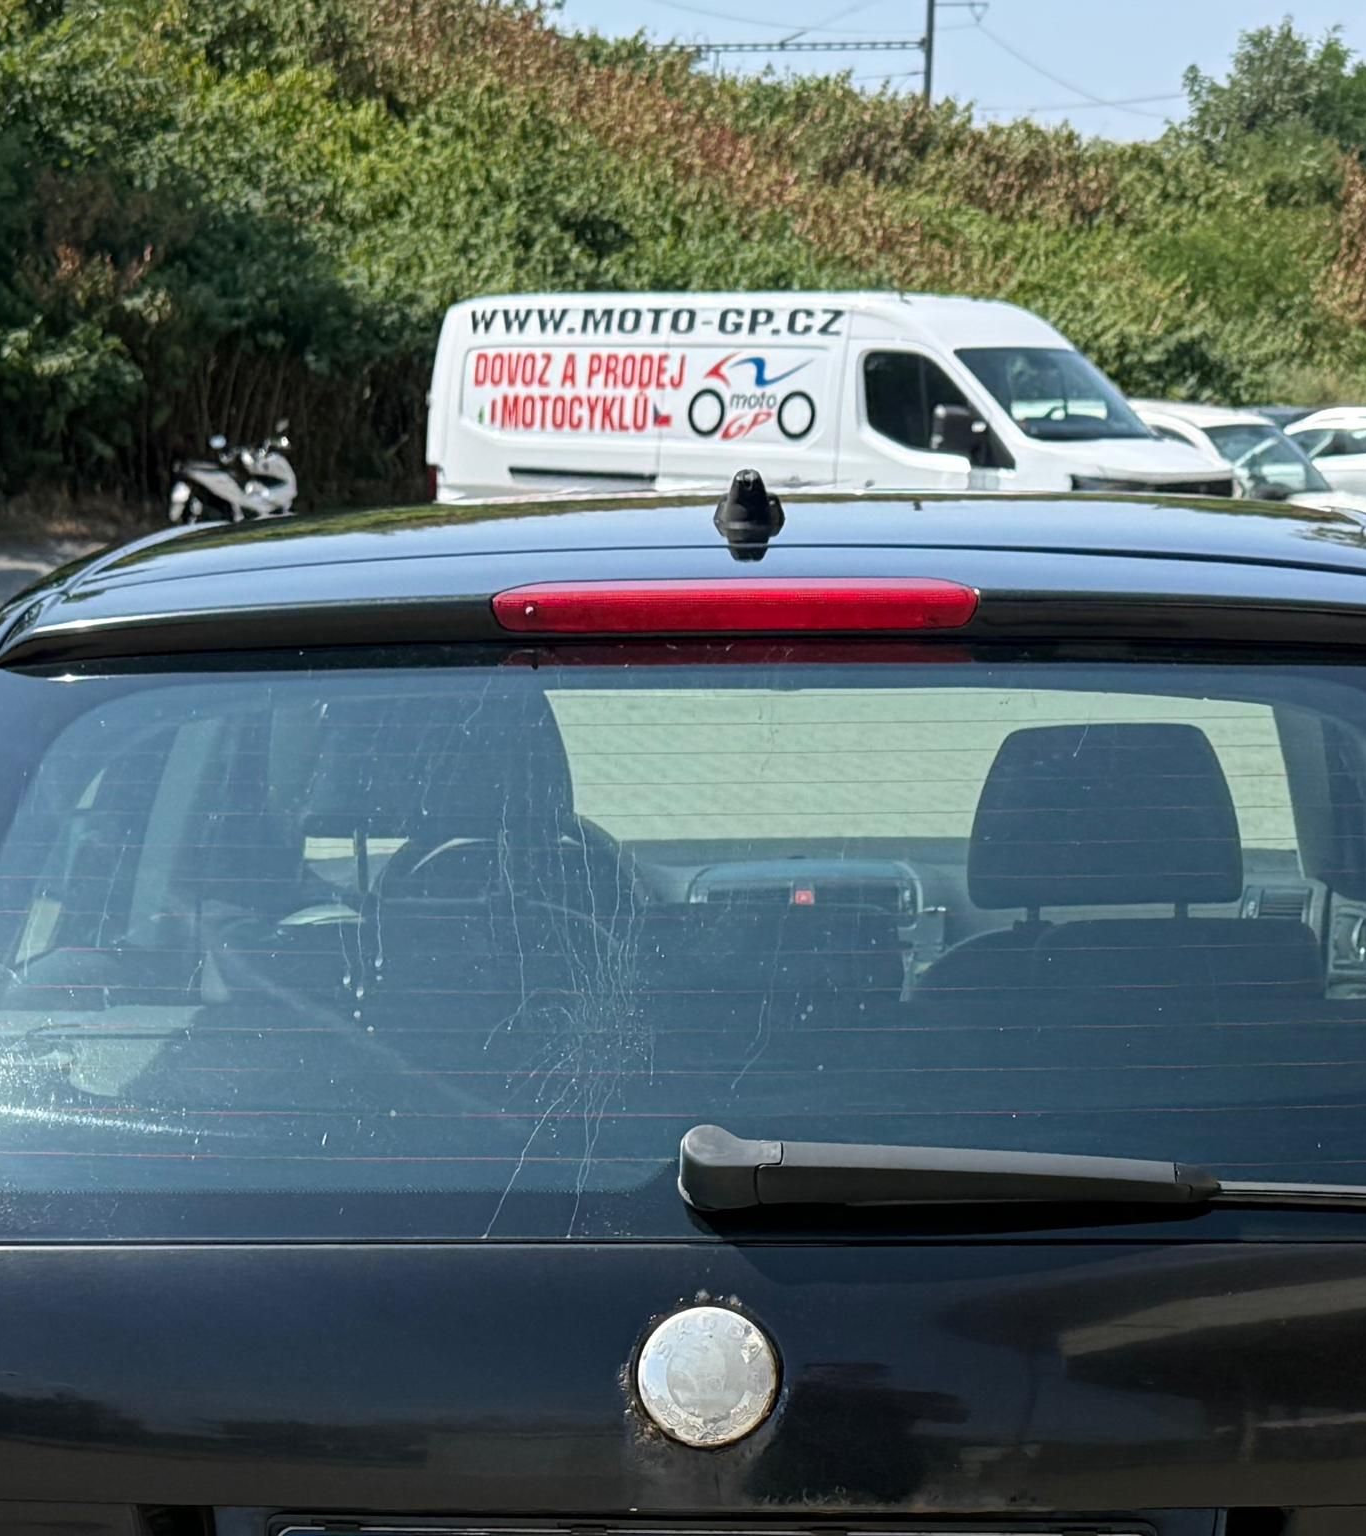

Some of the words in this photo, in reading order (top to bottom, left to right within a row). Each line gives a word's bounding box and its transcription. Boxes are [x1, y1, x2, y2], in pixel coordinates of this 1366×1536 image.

[470, 307, 845, 336] WWW.MOTO-GP.CZ
[474, 353, 553, 388] DOVOZ
[560, 353, 577, 389] A
[586, 353, 687, 390] PRODEJ
[501, 391, 649, 432] MOTOCYKLŮ
[729, 391, 778, 410] moto
[721, 411, 774, 440] GP
